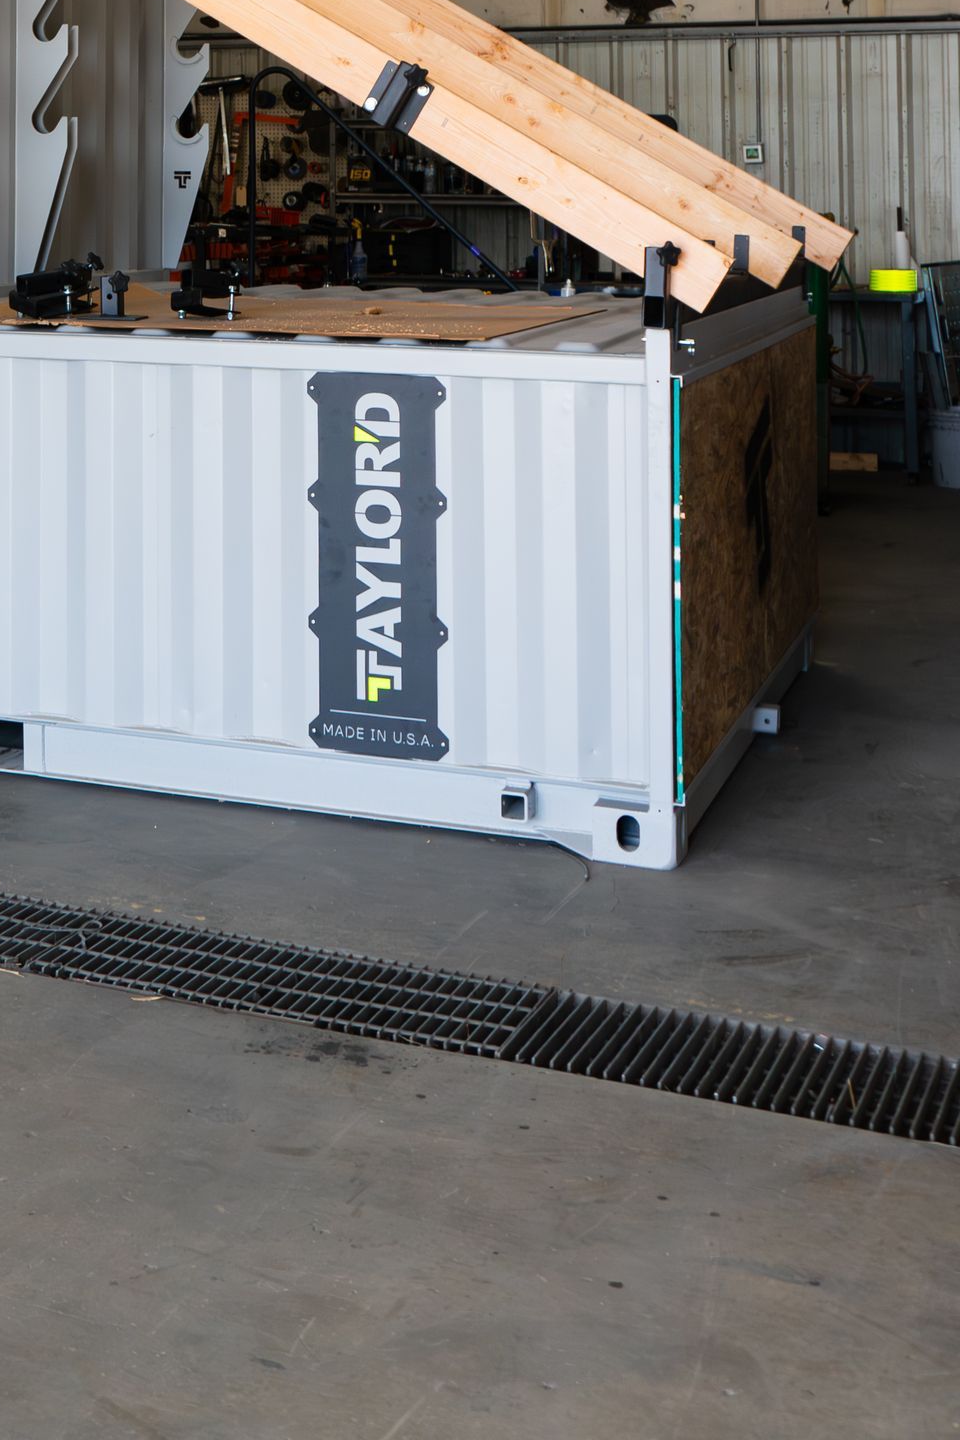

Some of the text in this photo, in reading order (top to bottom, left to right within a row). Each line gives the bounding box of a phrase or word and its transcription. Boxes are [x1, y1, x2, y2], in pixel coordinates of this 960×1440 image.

[322, 722, 435, 748] MADE IN U.S.A.
